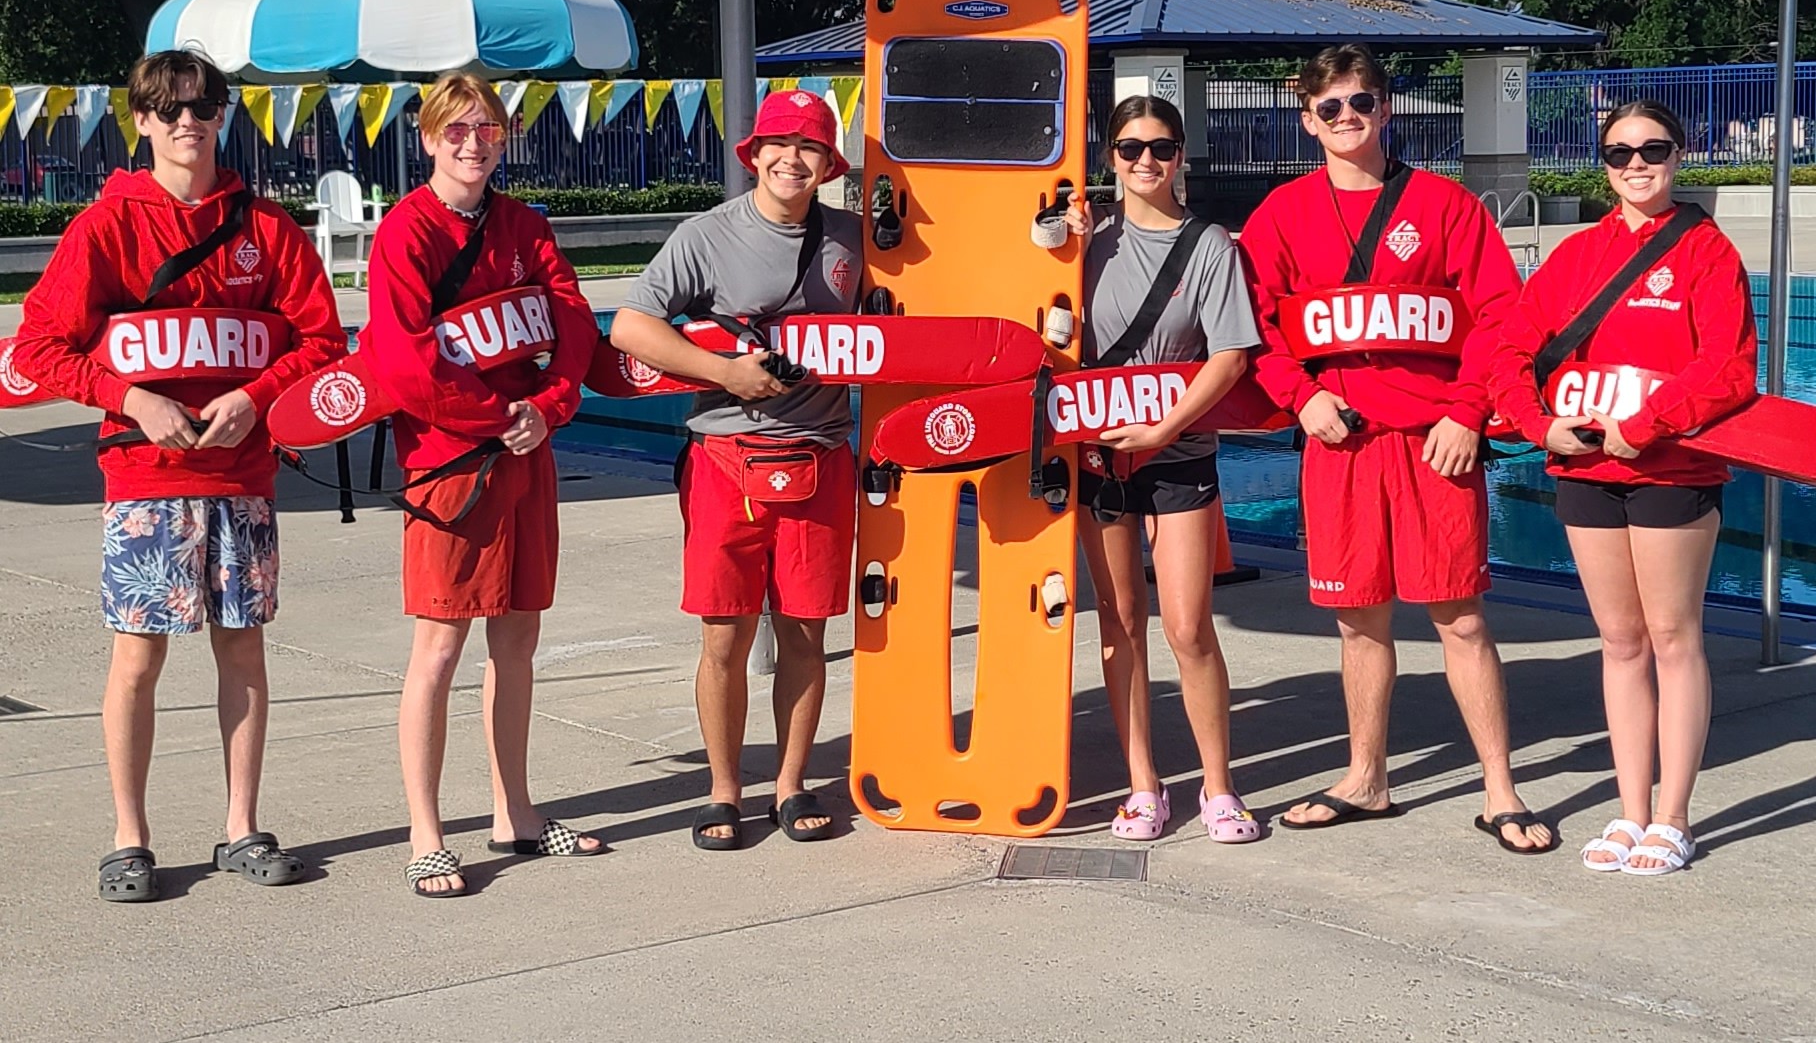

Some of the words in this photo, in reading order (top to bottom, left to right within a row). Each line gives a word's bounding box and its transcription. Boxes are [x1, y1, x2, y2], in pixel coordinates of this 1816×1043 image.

[1387, 234, 1420, 242] TRACY
[1303, 293, 1454, 346] GUARD
[108, 318, 270, 374] GUARD
[310, 372, 336, 410] LIFEGUARD
[1047, 372, 1187, 434] GUARD
[924, 402, 954, 433] LIFEGUARD
[1310, 578, 1345, 592] UARD
